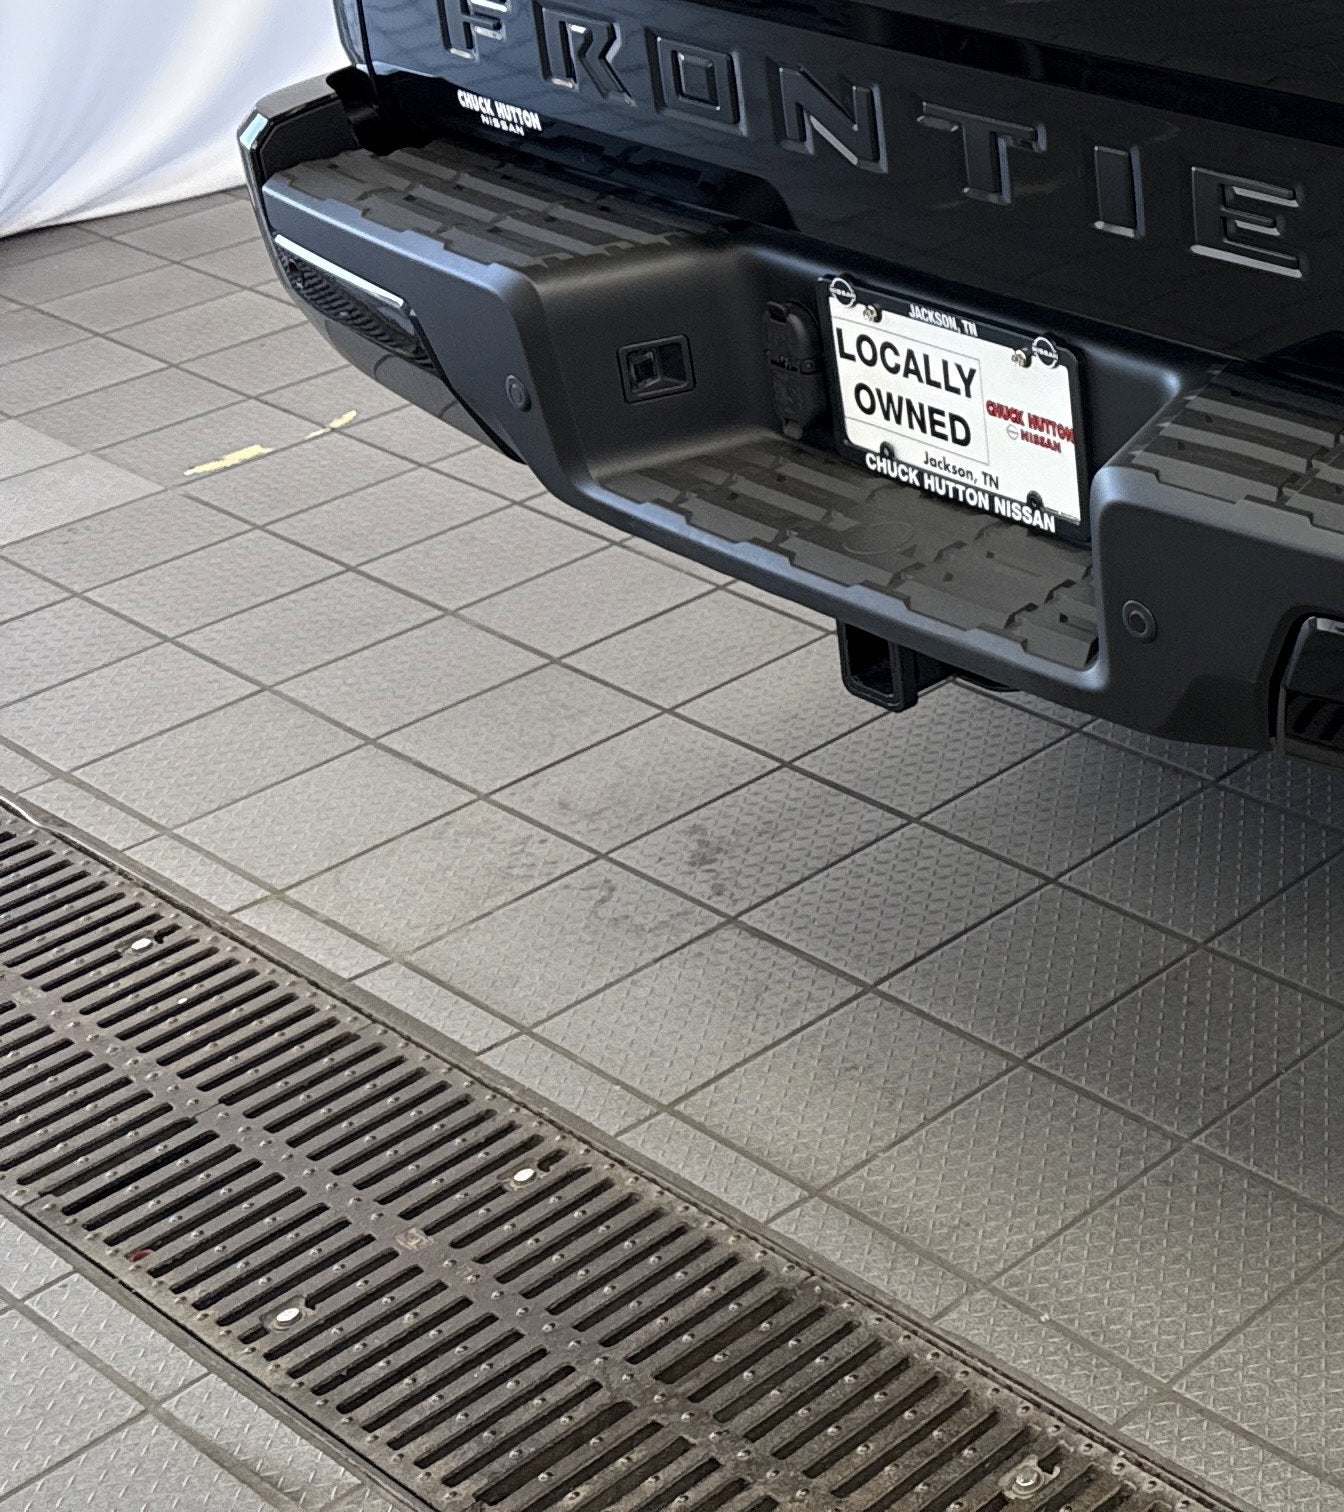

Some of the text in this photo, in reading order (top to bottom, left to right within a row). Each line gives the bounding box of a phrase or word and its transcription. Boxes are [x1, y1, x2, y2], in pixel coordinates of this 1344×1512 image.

[457, 89, 543, 132] CHUCK HUTTON
[480, 113, 525, 137] NISSAN
[908, 303, 978, 337] JACKSON, TN
[836, 327, 977, 399] LOCALLY
[854, 382, 972, 447] OWNED
[986, 399, 1075, 445] CHUCK HUTTON
[865, 451, 920, 487] CHUCK
[924, 472, 989, 511] HUTTON
[994, 498, 1056, 534] NISSAN
[923, 451, 1000, 490] Jackson, TN
